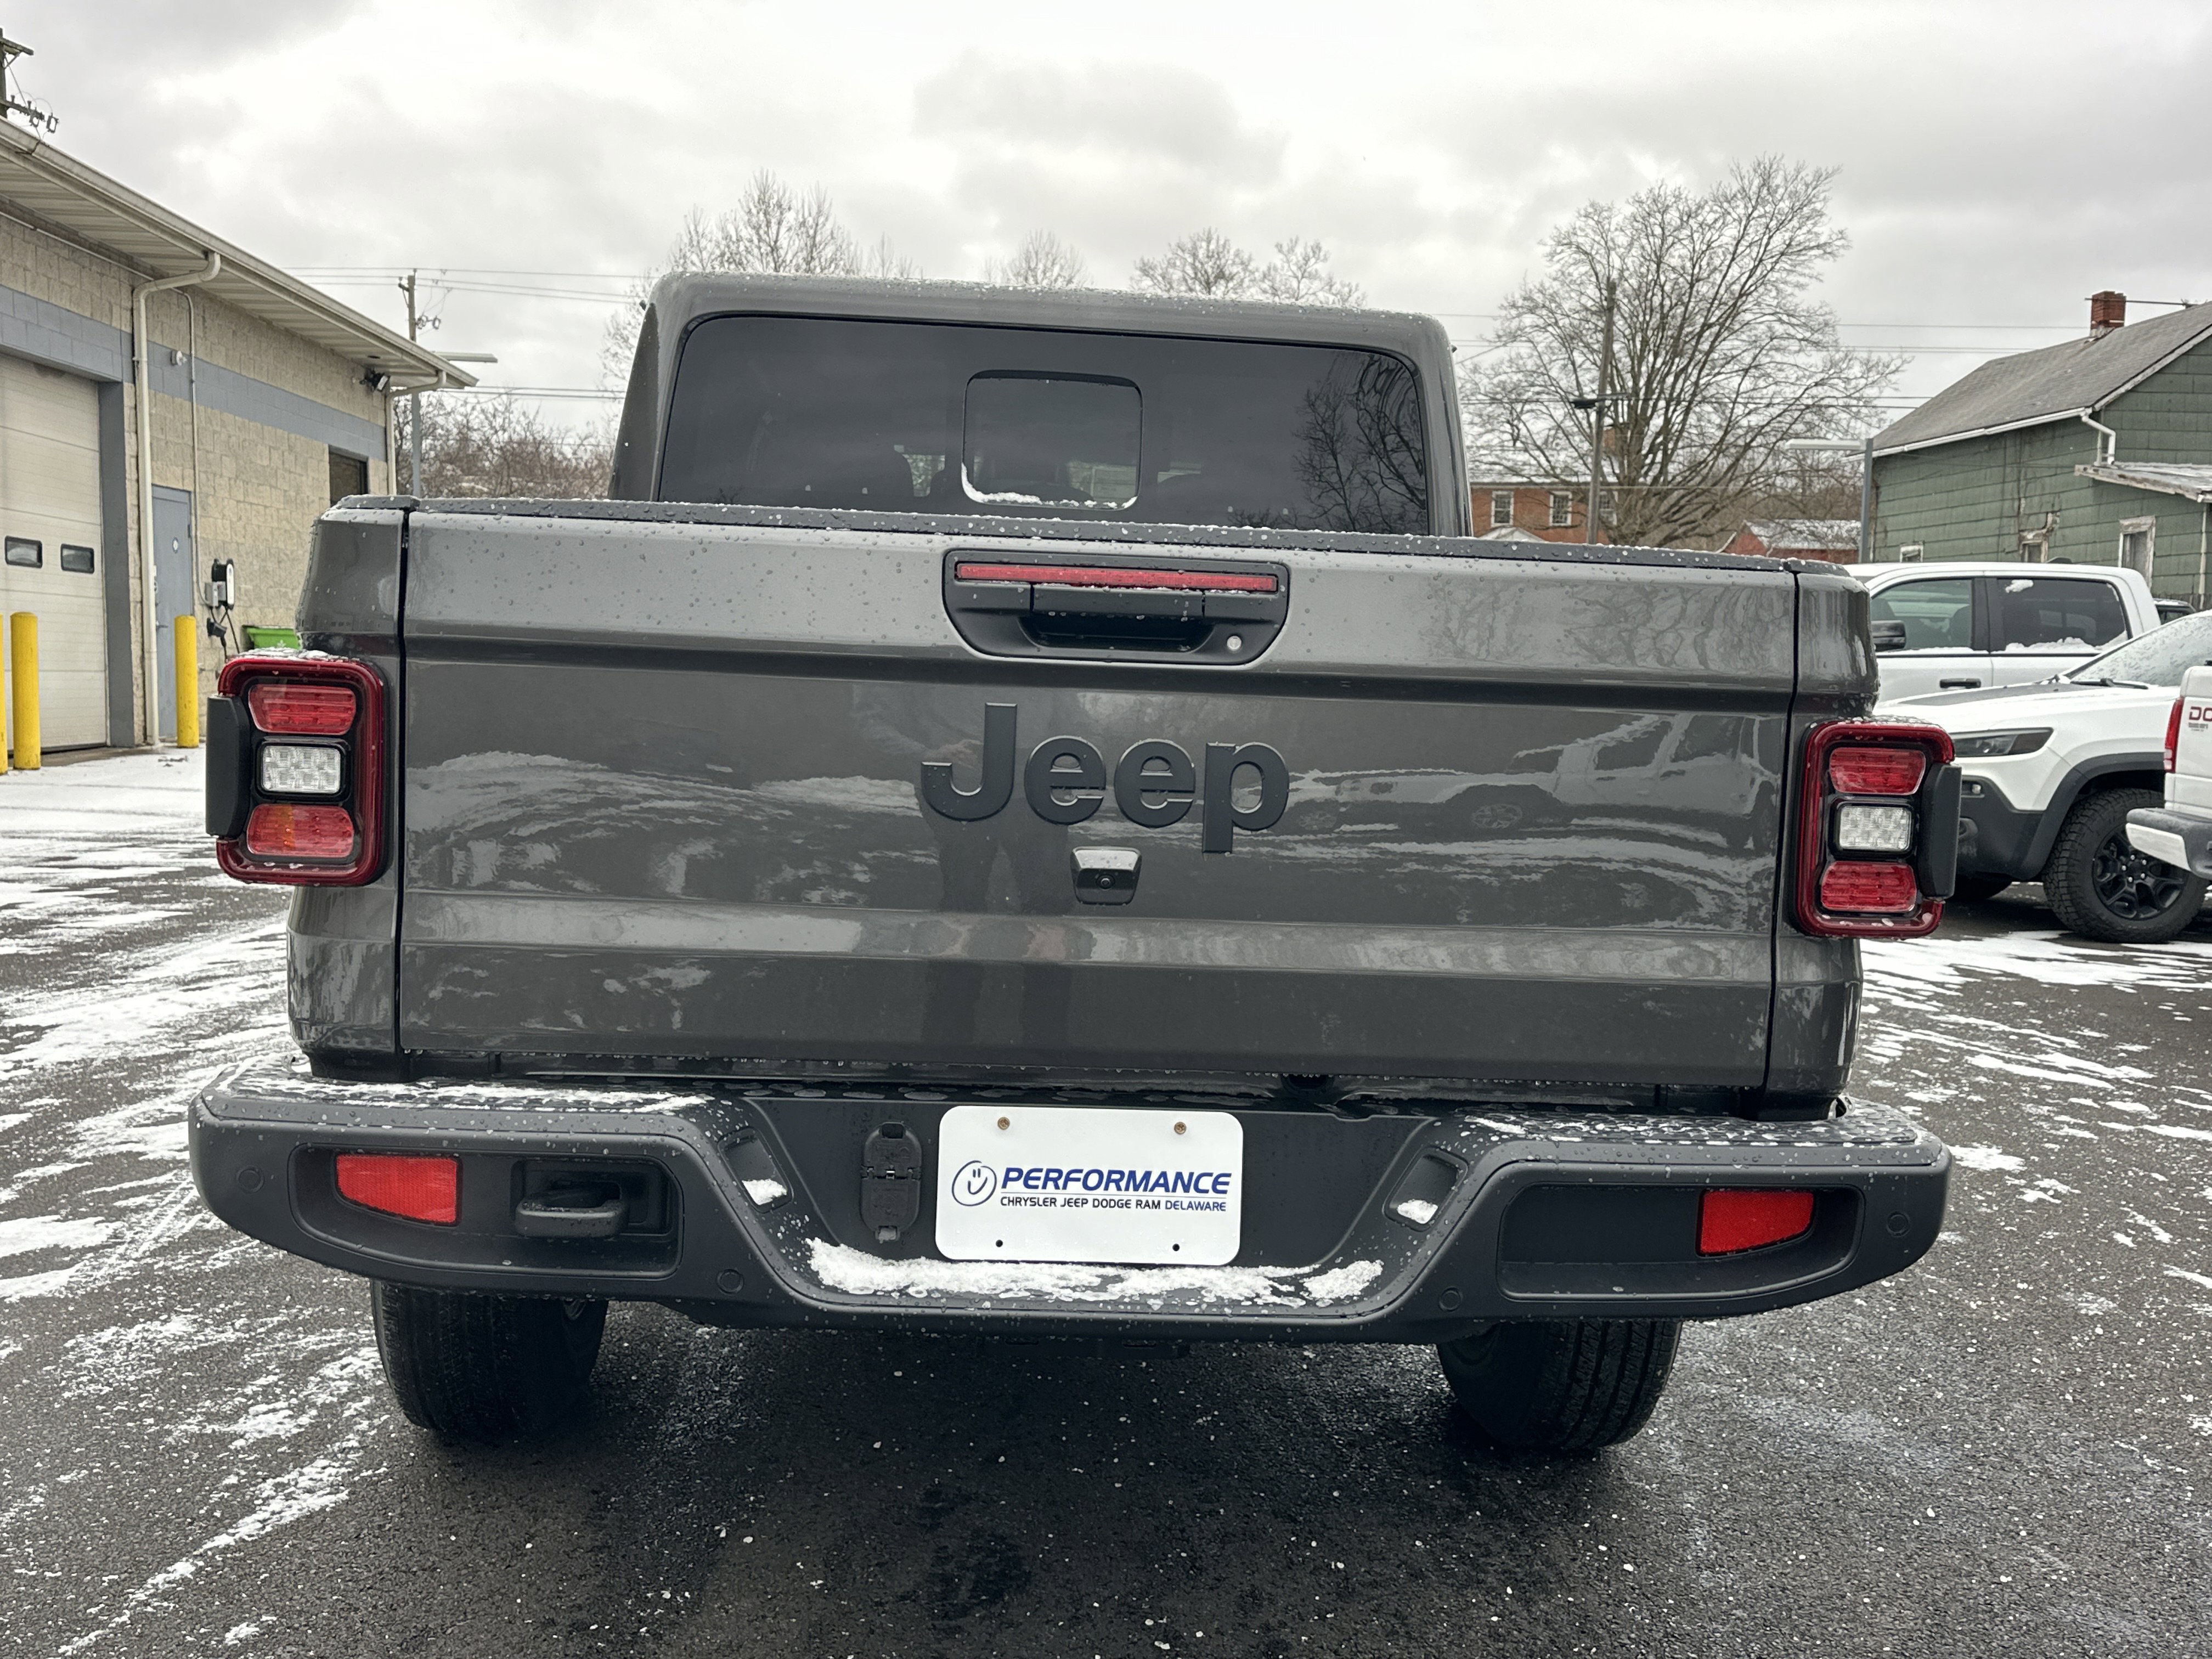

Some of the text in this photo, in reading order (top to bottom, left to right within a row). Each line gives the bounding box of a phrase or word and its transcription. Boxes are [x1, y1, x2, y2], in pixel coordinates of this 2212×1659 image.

[921, 702, 1290, 854] Jeep
[1001, 1167, 1232, 1194] PERFORMANCE
[1000, 1196, 1227, 1212] CHRYSLER JEEP DODGE RAM DELAWARE
